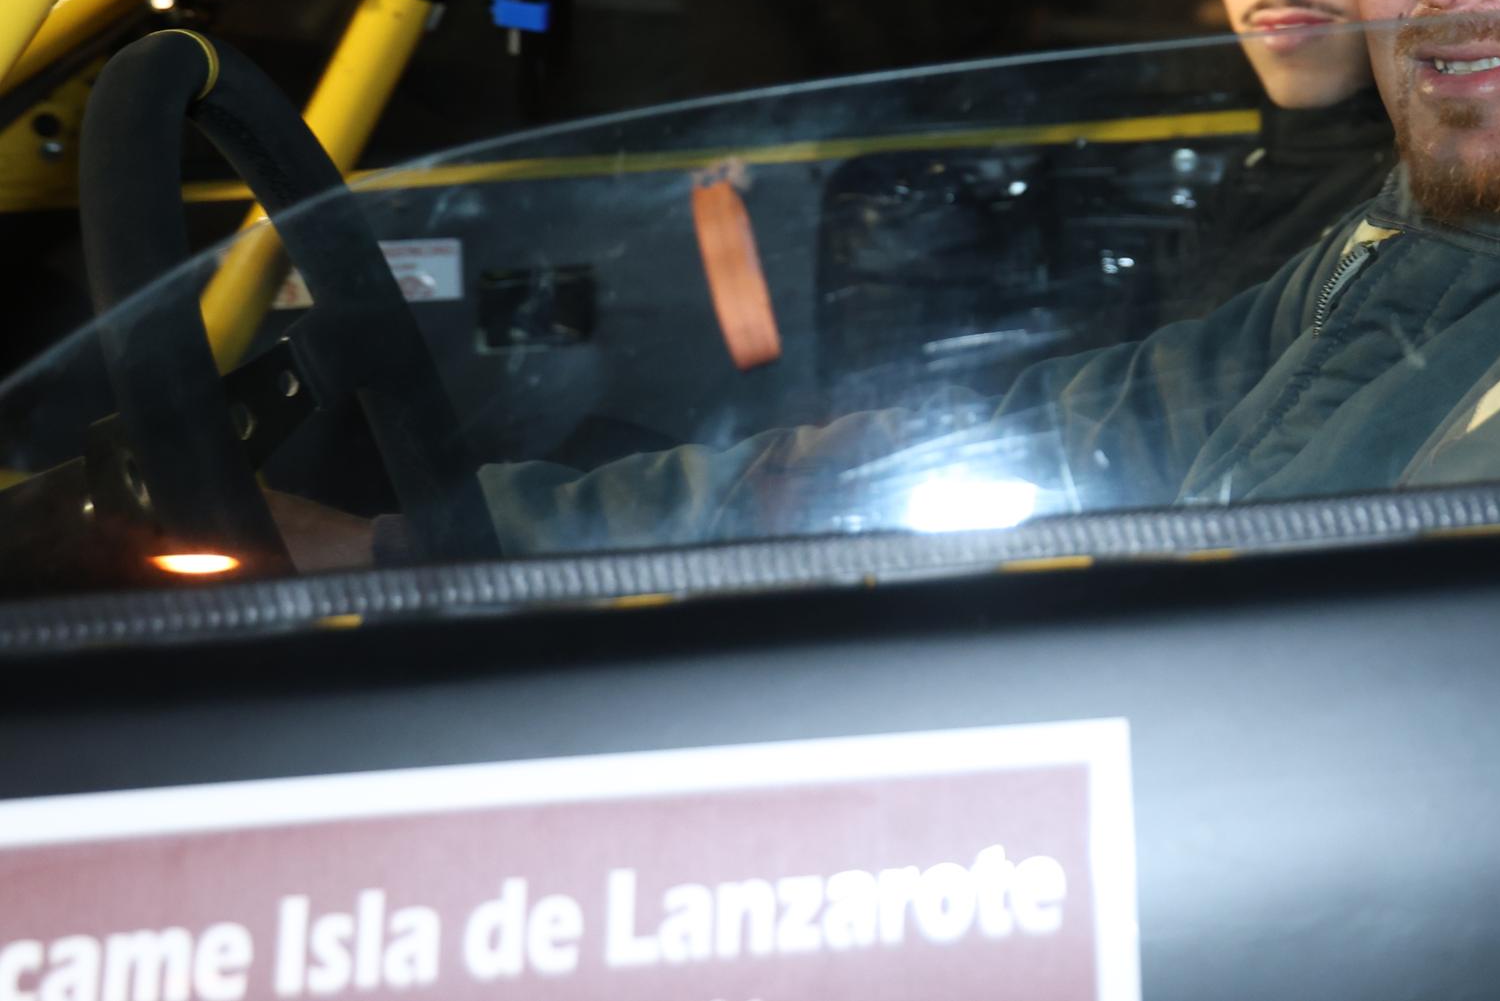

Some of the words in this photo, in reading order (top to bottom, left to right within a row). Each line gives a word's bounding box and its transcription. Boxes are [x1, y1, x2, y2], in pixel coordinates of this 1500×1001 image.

[273, 887, 441, 996] Isla
[462, 876, 585, 980] de
[605, 843, 1067, 968] Lanzarote
